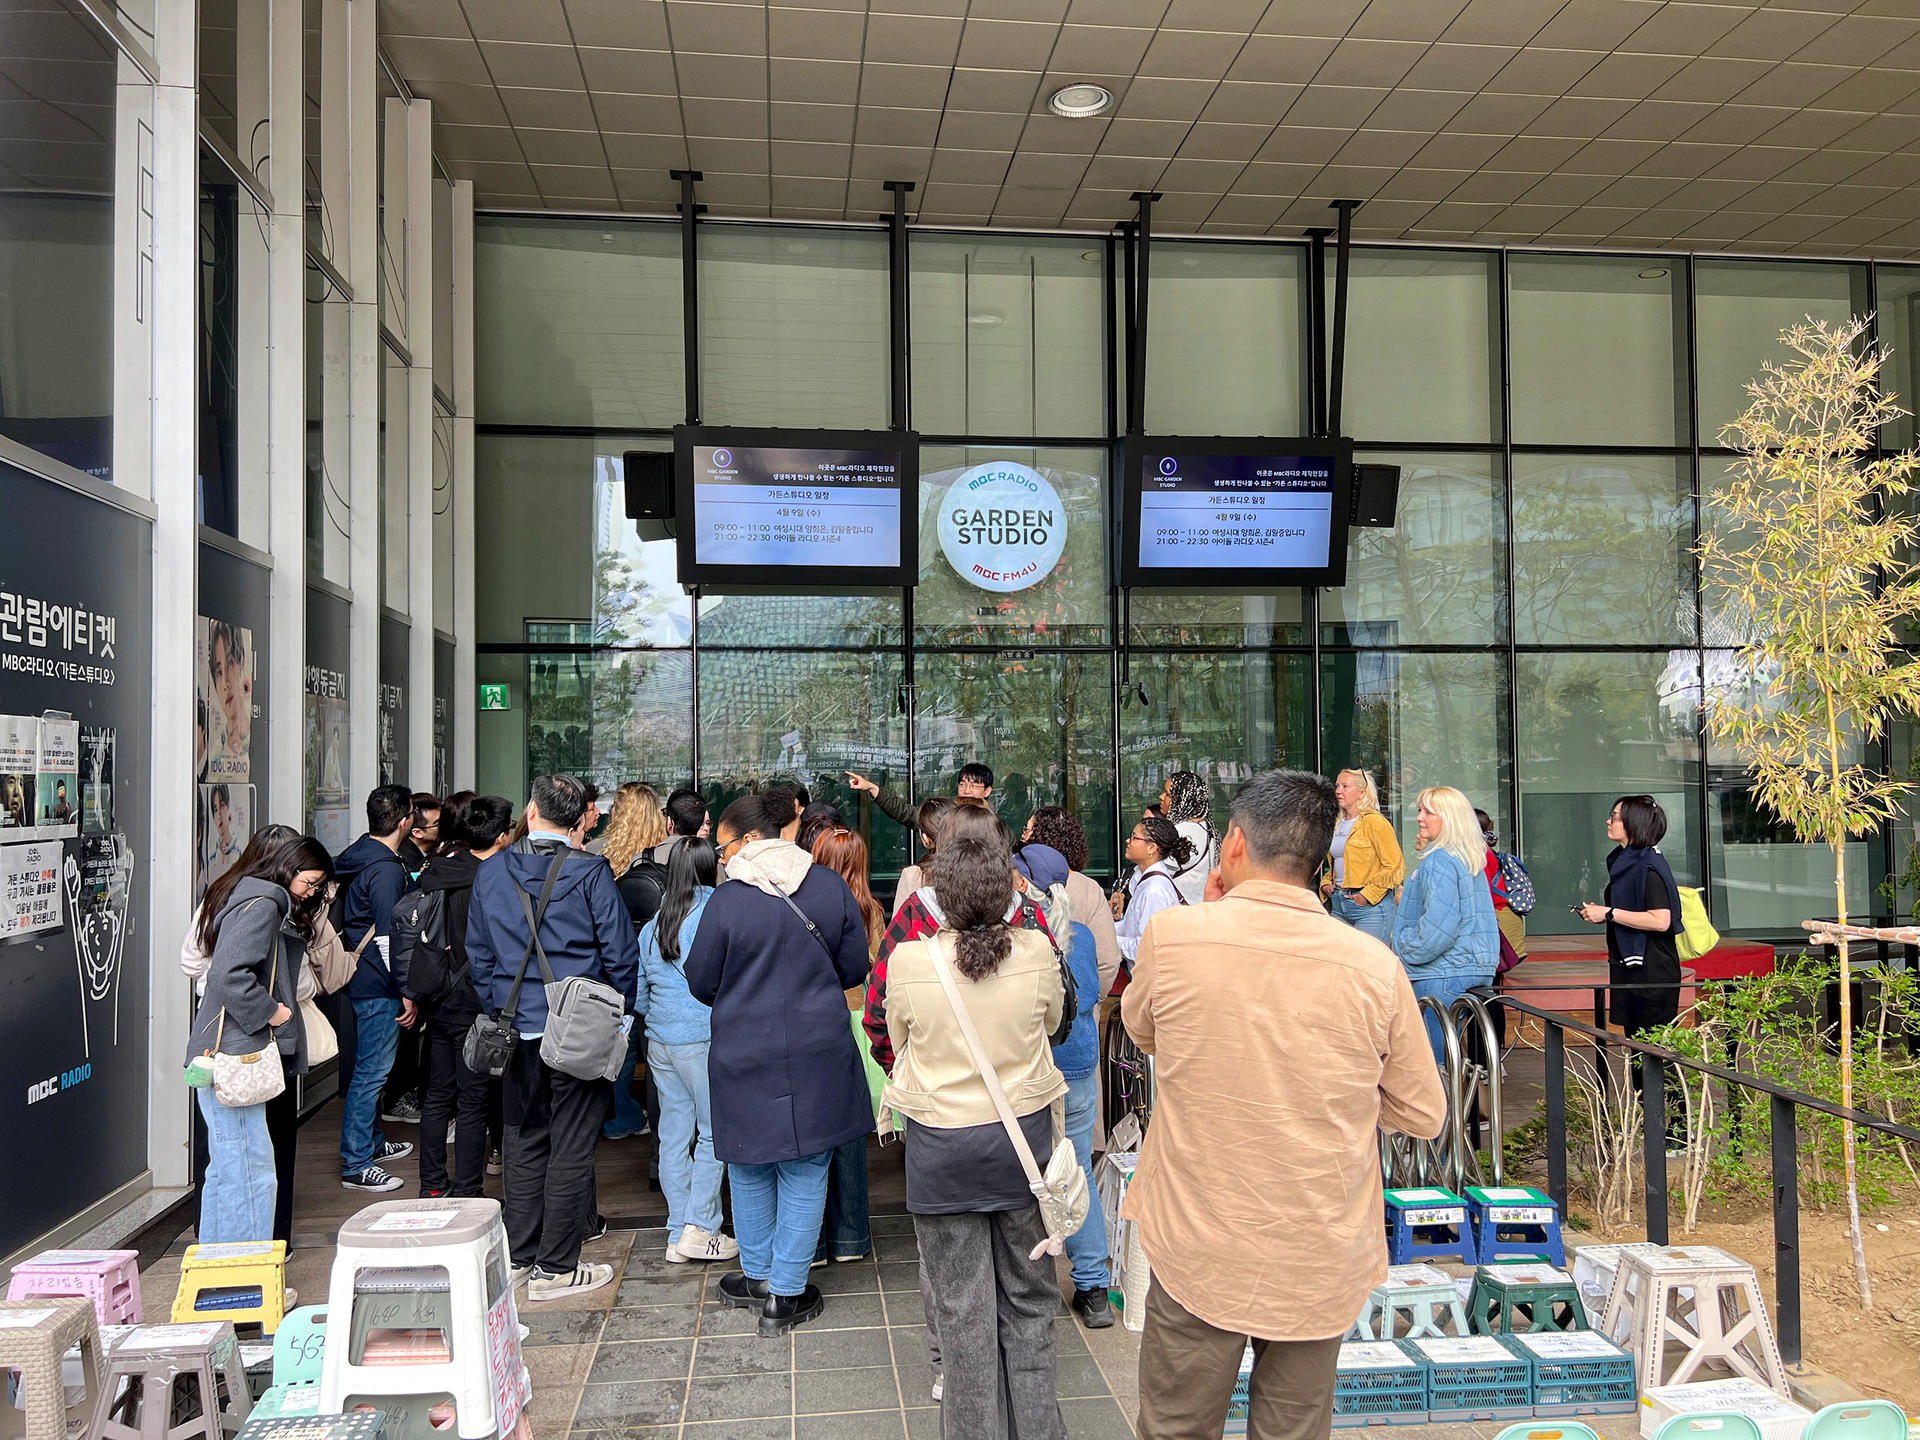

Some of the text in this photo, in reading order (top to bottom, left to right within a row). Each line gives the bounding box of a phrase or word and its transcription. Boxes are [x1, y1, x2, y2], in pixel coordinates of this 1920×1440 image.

[968, 472, 1038, 492] MBC RADIO
[768, 490, 829, 500] 가든스튜디오 일정
[1208, 496, 1266, 505] 가든스튜디오 일정
[777, 509, 821, 517] 4월 9일 (수)
[952, 509, 1053, 527] GARDEN
[1215, 513, 1257, 521] 4월 9일 (수)
[774, 524, 803, 533] 여성시대
[1212, 528, 1239, 537] 여성시대
[774, 534, 796, 542] 아이돌
[822, 535, 841, 543] 시즌4
[958, 528, 1048, 545] STUDIO
[1212, 538, 1232, 546] 아이돌
[1234, 538, 1254, 546] 라디오
[1256, 538, 1274, 546] 시즌4
[972, 562, 1037, 581] MBC FM4U
[0, 591, 116, 659] 관람에티켓
[227, 762, 247, 773] RADIO
[27, 1063, 91, 1105] MBC RADIO
